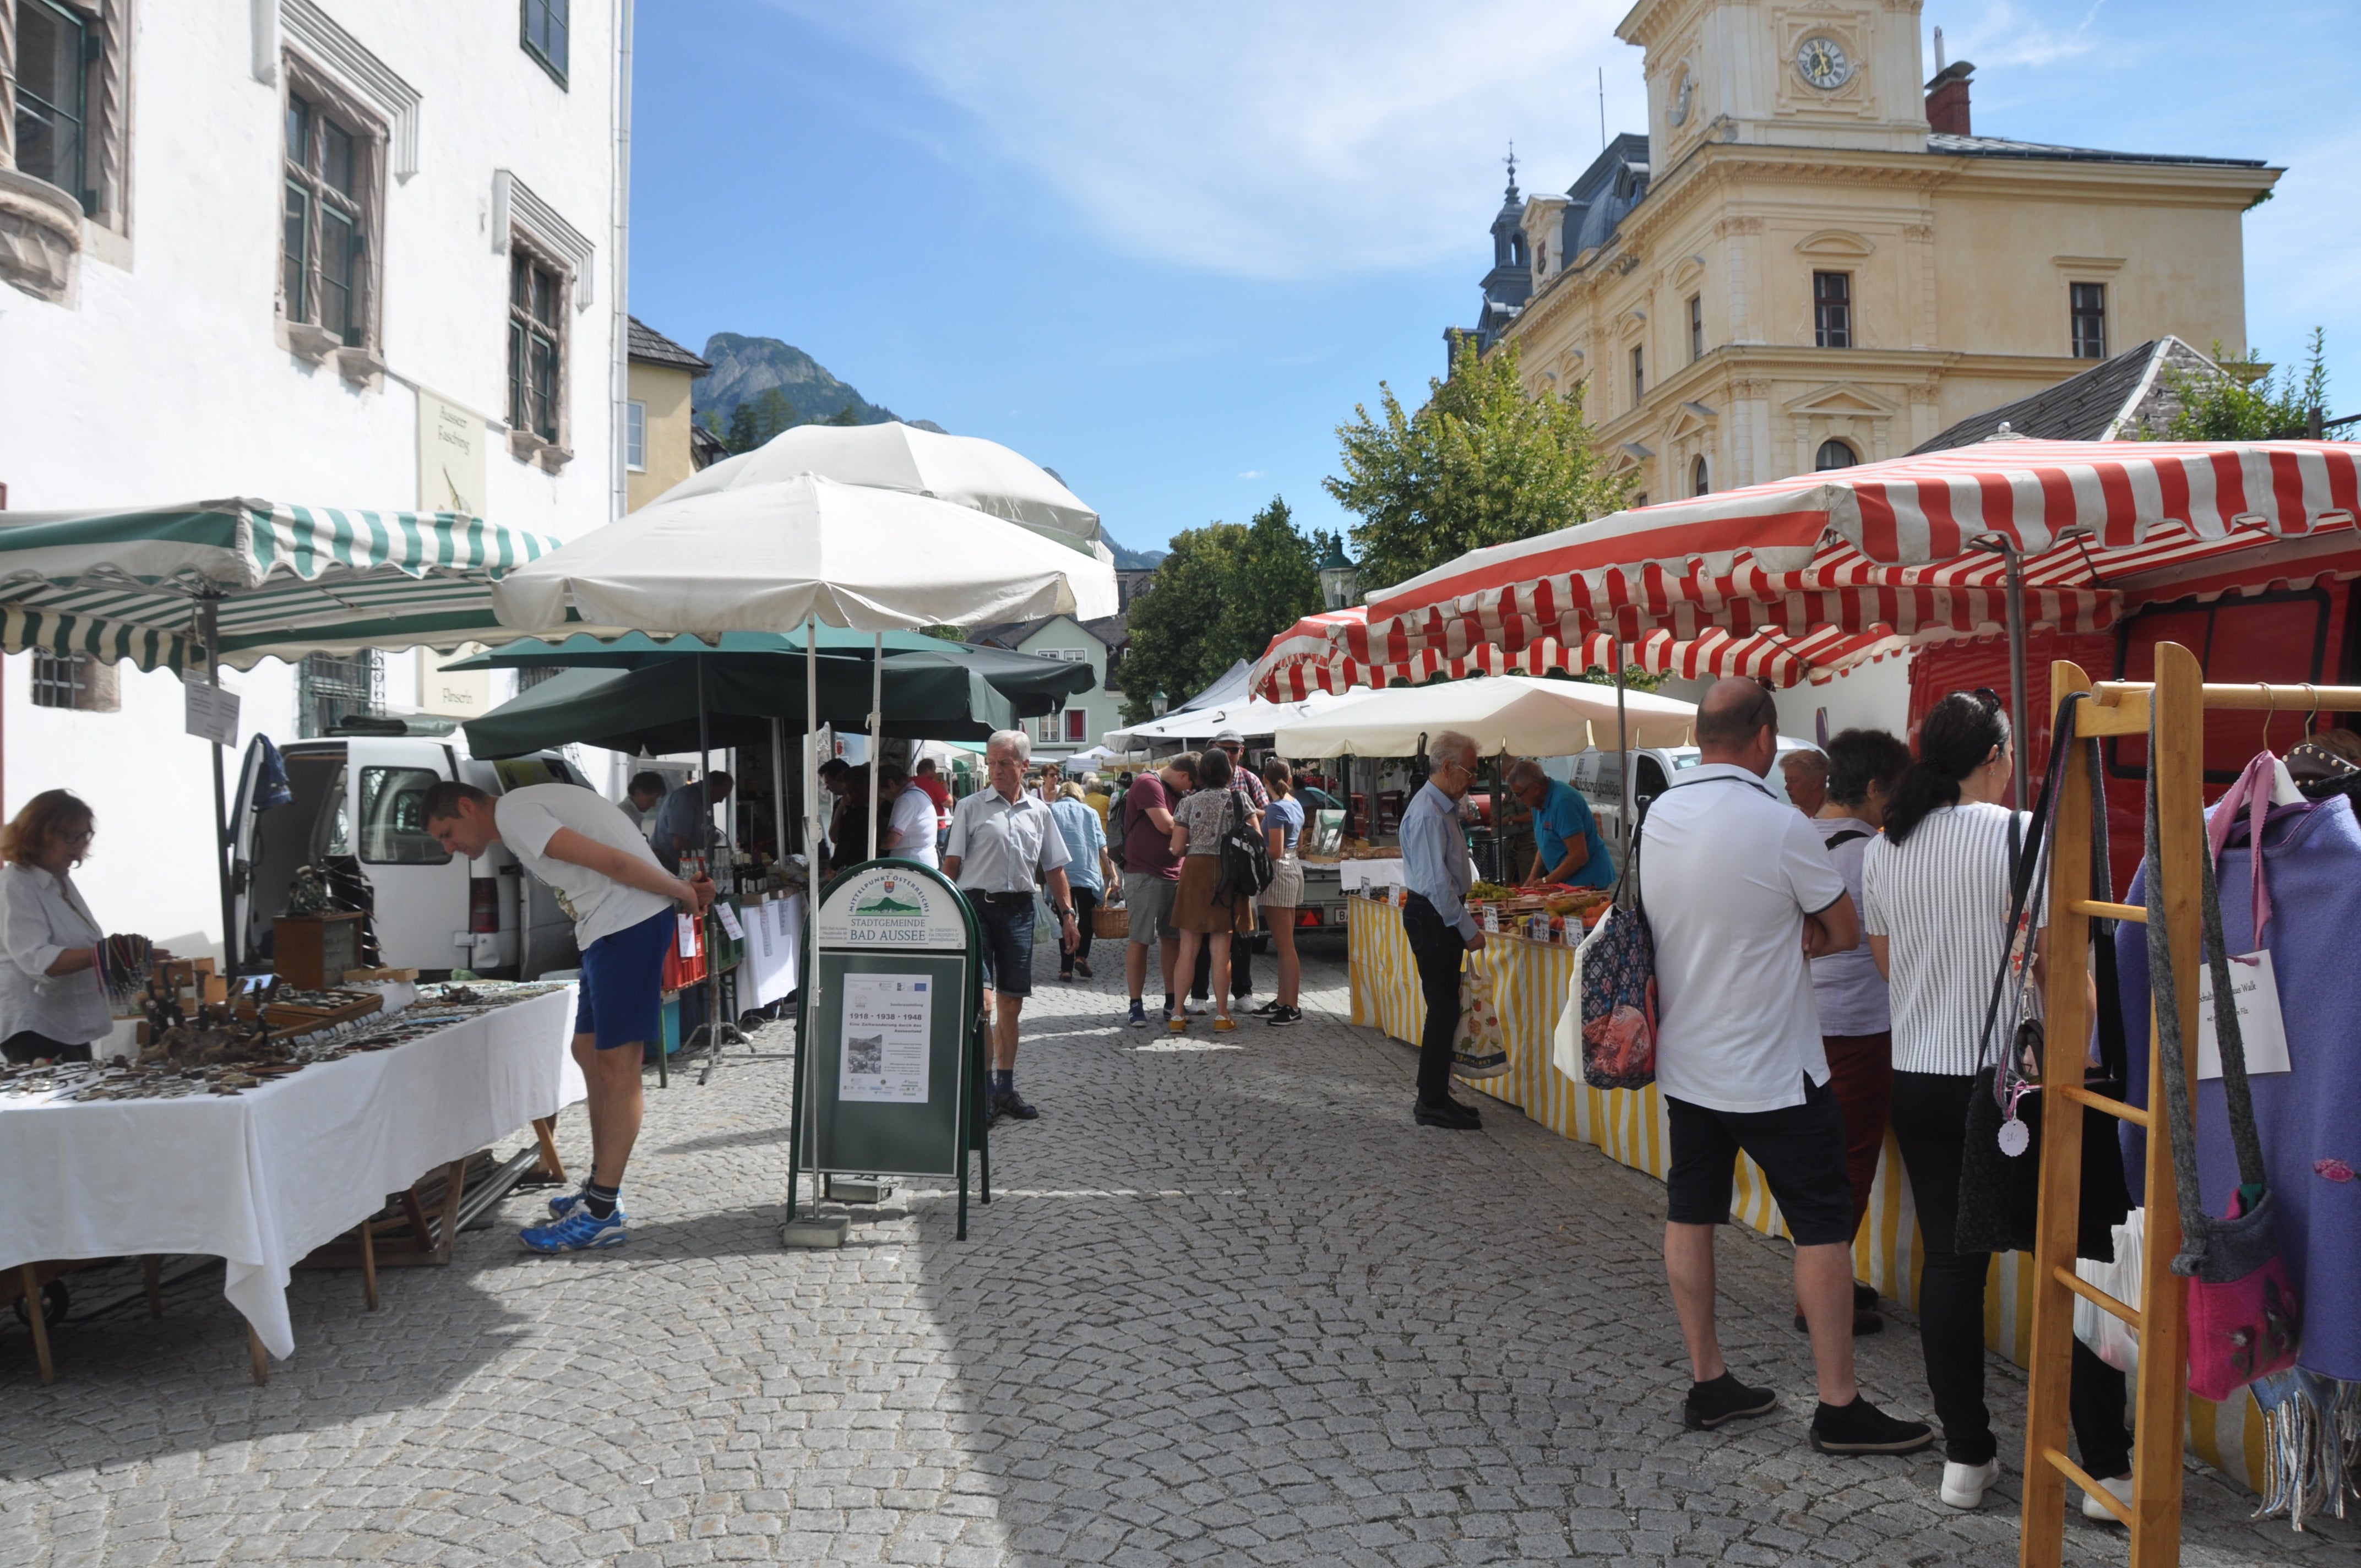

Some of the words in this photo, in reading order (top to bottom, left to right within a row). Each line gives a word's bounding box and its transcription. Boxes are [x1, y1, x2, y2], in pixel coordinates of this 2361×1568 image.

[438, 424, 470, 455] Fasching
[848, 875, 890, 912] MITTELPUNKT
[893, 874, 930, 912] ÖSTERREICHS
[851, 918, 926, 927] STADTGEMEINDE
[850, 930, 876, 940] BAD
[879, 930, 926, 941] AUSSEE
[2240, 980, 2257, 993] Walk
